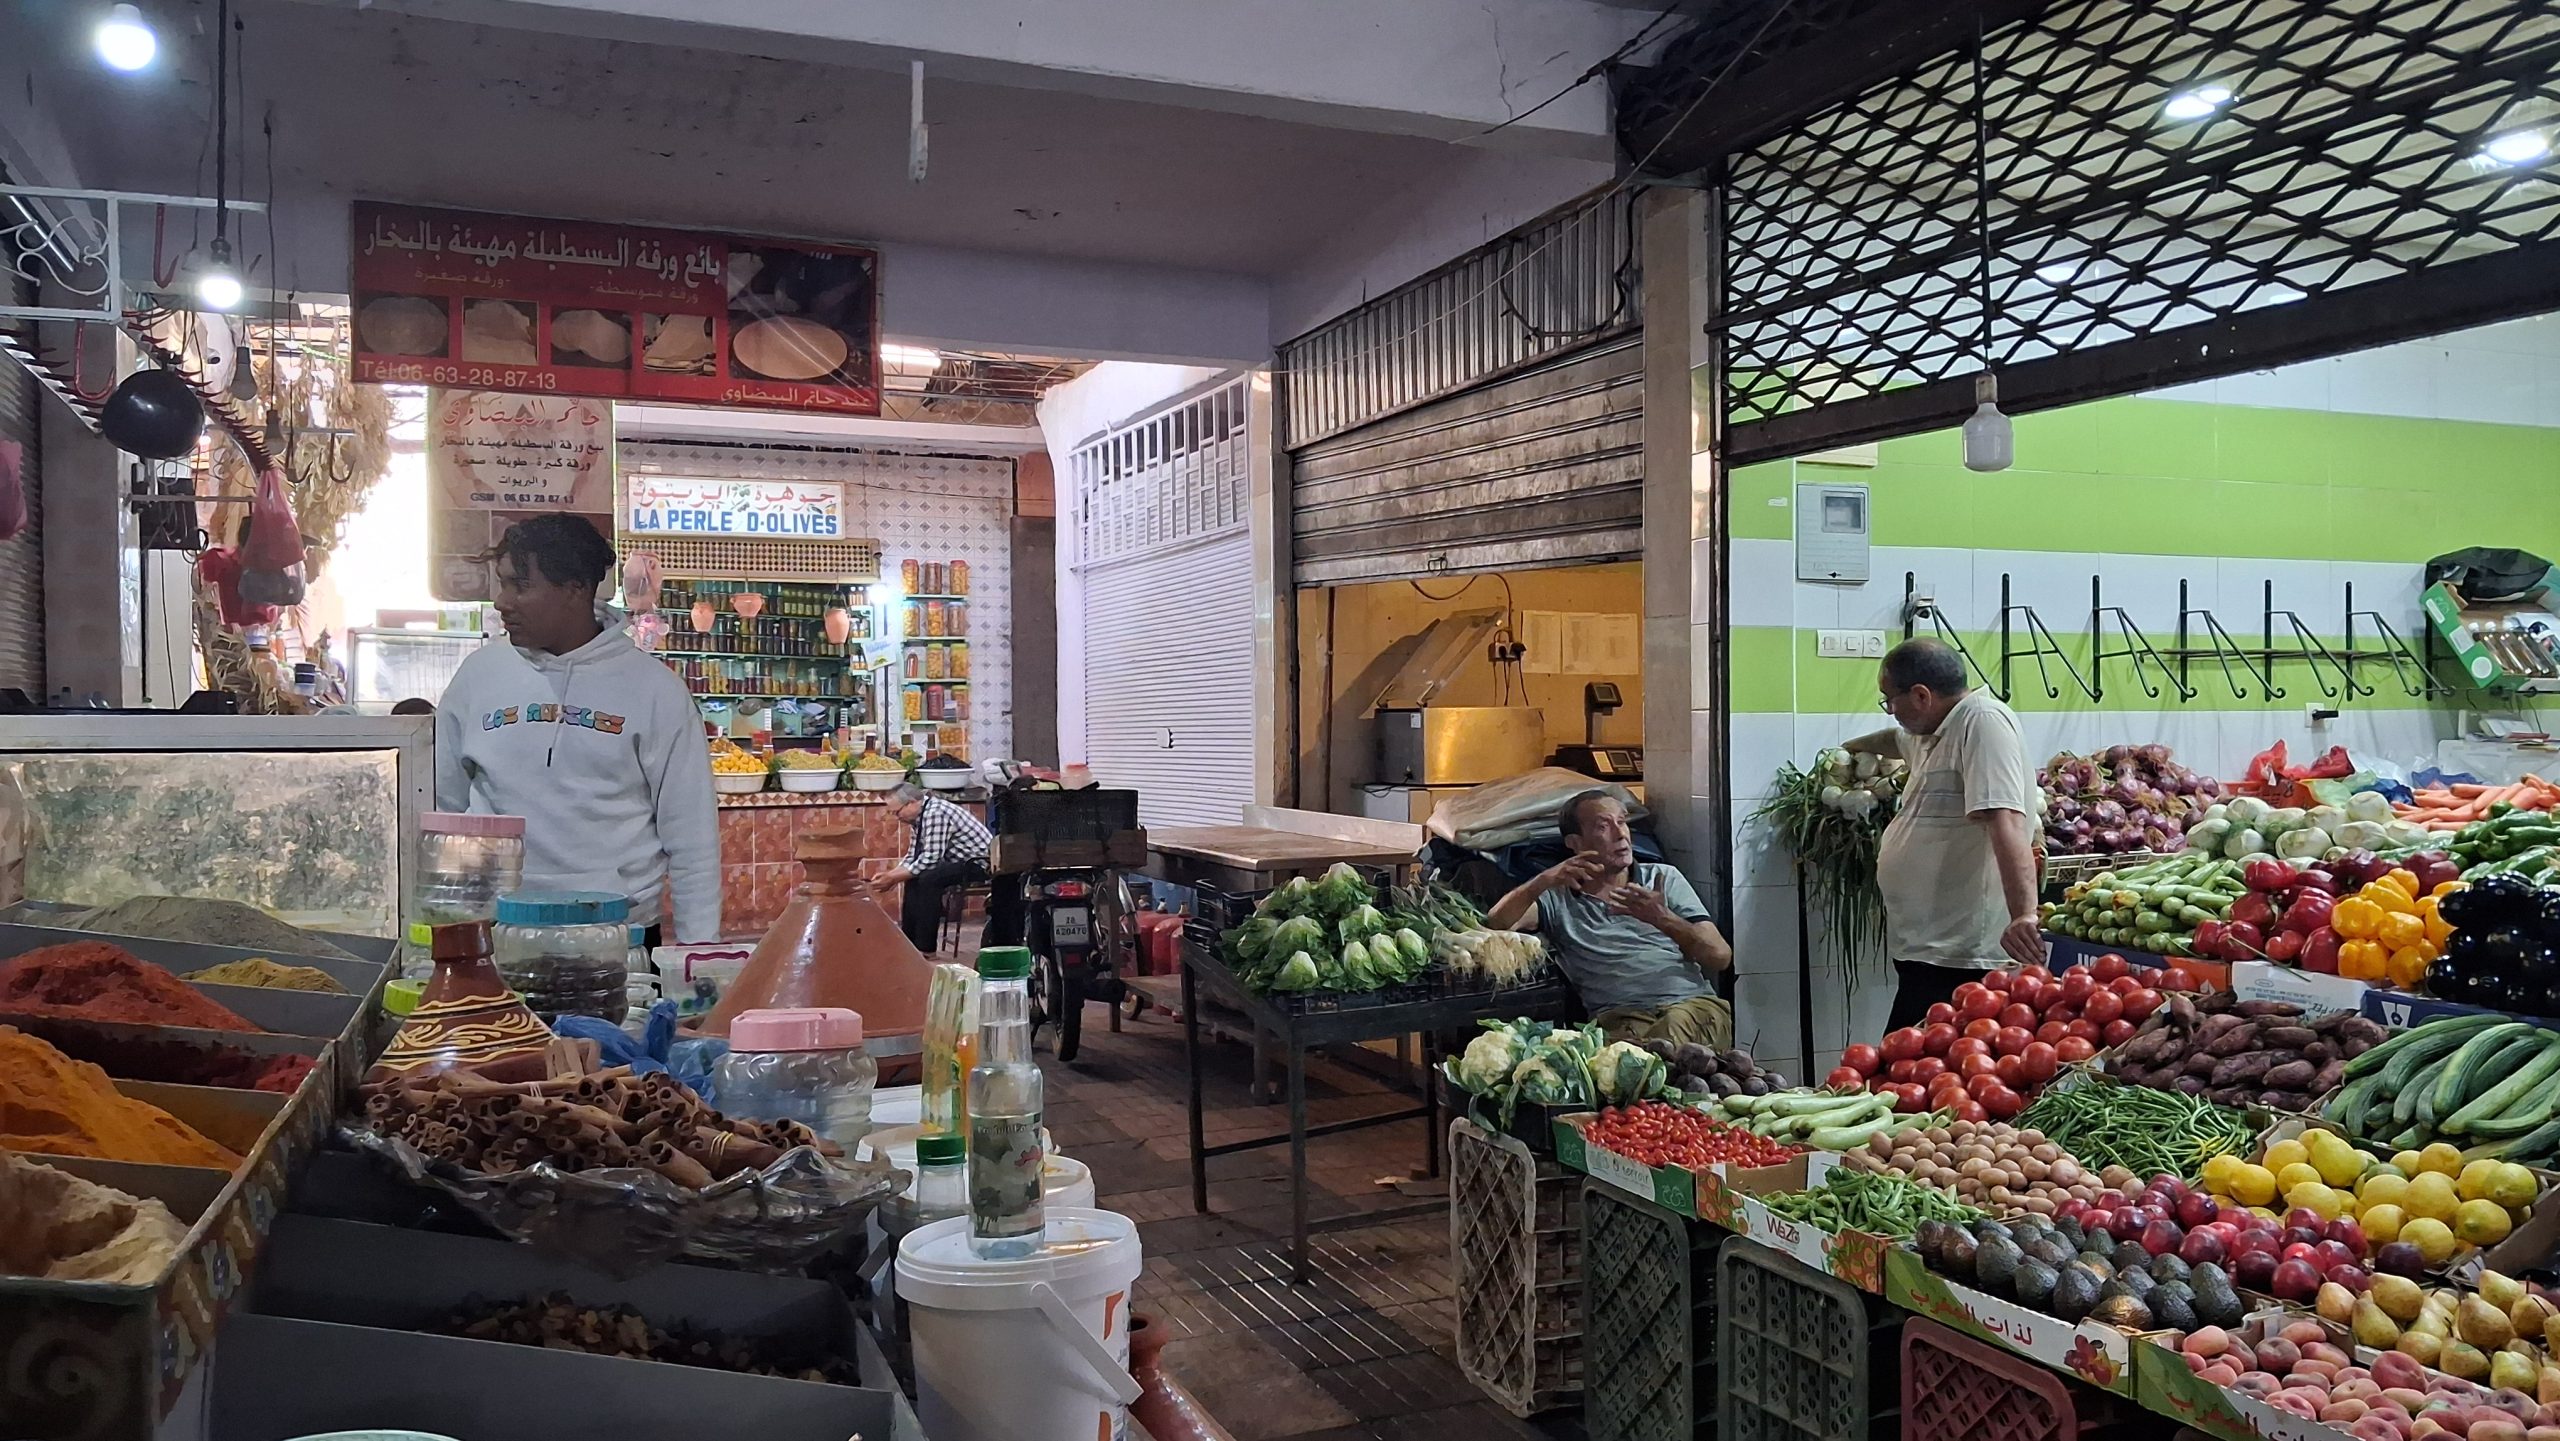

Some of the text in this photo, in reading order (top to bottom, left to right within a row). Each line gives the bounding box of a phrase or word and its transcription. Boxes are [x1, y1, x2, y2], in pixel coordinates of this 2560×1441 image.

[364, 214, 721, 288] بائع ورقة البسطيلة مهيئة بالبخار
[720, 384, 798, 405] البيضاوي
[803, 390, 836, 409] حاتم
[556, 397, 600, 426] حاتم
[511, 438, 556, 451] البسطيلة
[560, 439, 583, 453] ورقة
[566, 458, 591, 472] ورقة
[634, 508, 660, 529] LA
[667, 509, 733, 531] PERLE
[482, 705, 519, 731] LOS
